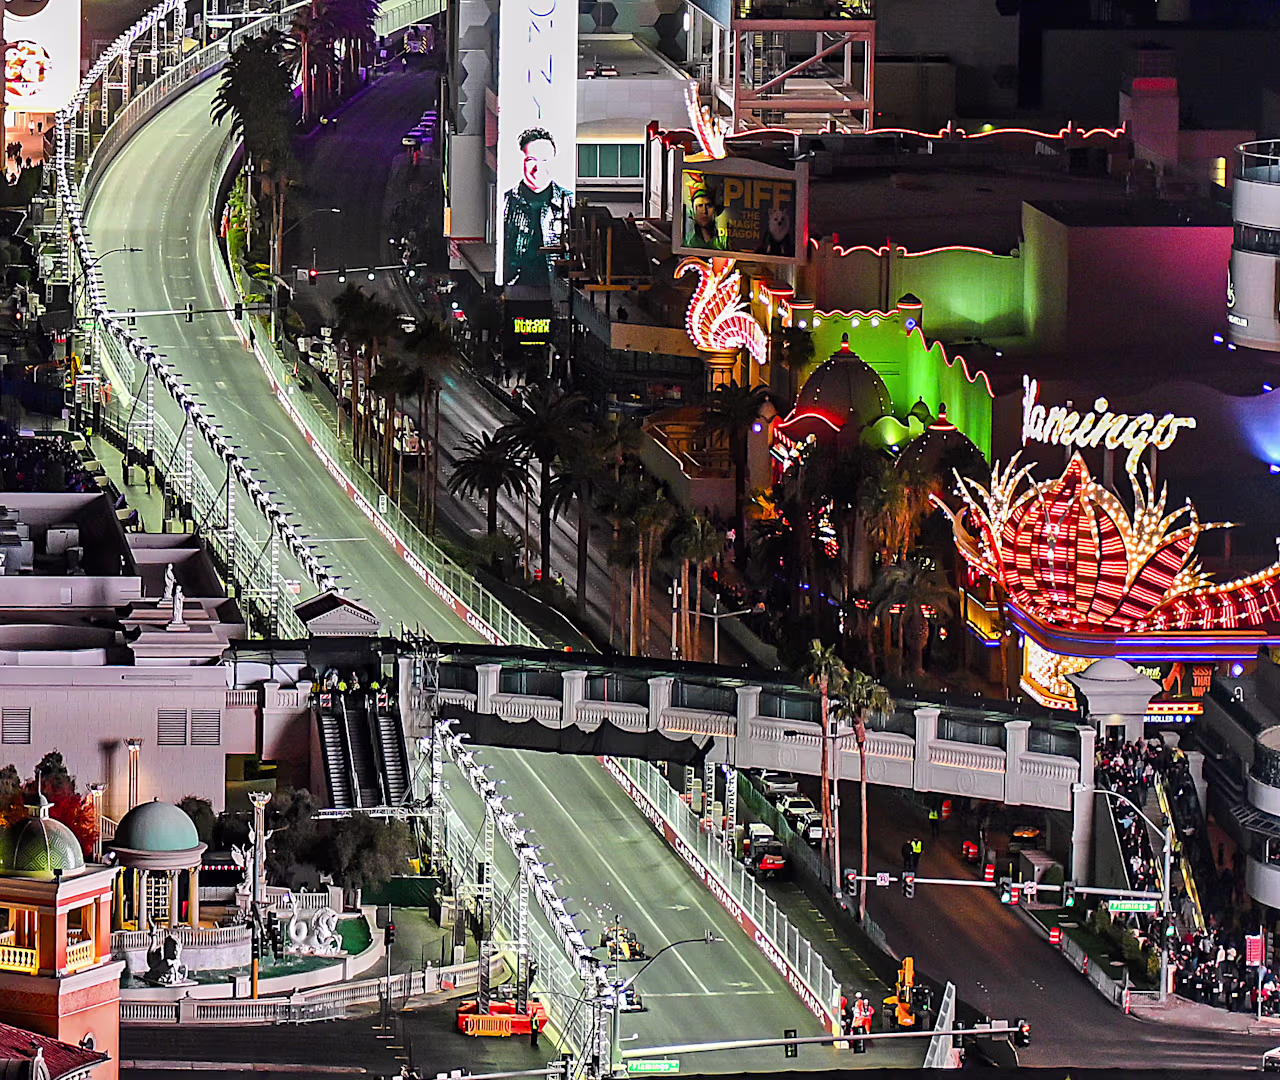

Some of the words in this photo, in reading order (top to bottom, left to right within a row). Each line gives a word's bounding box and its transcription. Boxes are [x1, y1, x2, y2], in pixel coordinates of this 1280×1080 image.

[723, 177, 793, 210] PIFF
[728, 220, 760, 230] MAGIC
[742, 211, 760, 220] THE
[717, 228, 760, 239] DRAGON
[403, 550, 427, 583] CAESARS
[427, 571, 457, 610] REWARDS
[466, 612, 496, 645] CAESARS
[1193, 676, 1212, 687] THAT
[1150, 715, 1174, 723] ROLLER
[603, 755, 632, 796] CAESARS
[631, 786, 666, 837] REWARDS
[674, 837, 706, 881] CAESARS
[707, 873, 744, 925] REWARDS
[754, 930, 788, 978] CAESARS
[788, 970, 826, 1026] REWARDS
